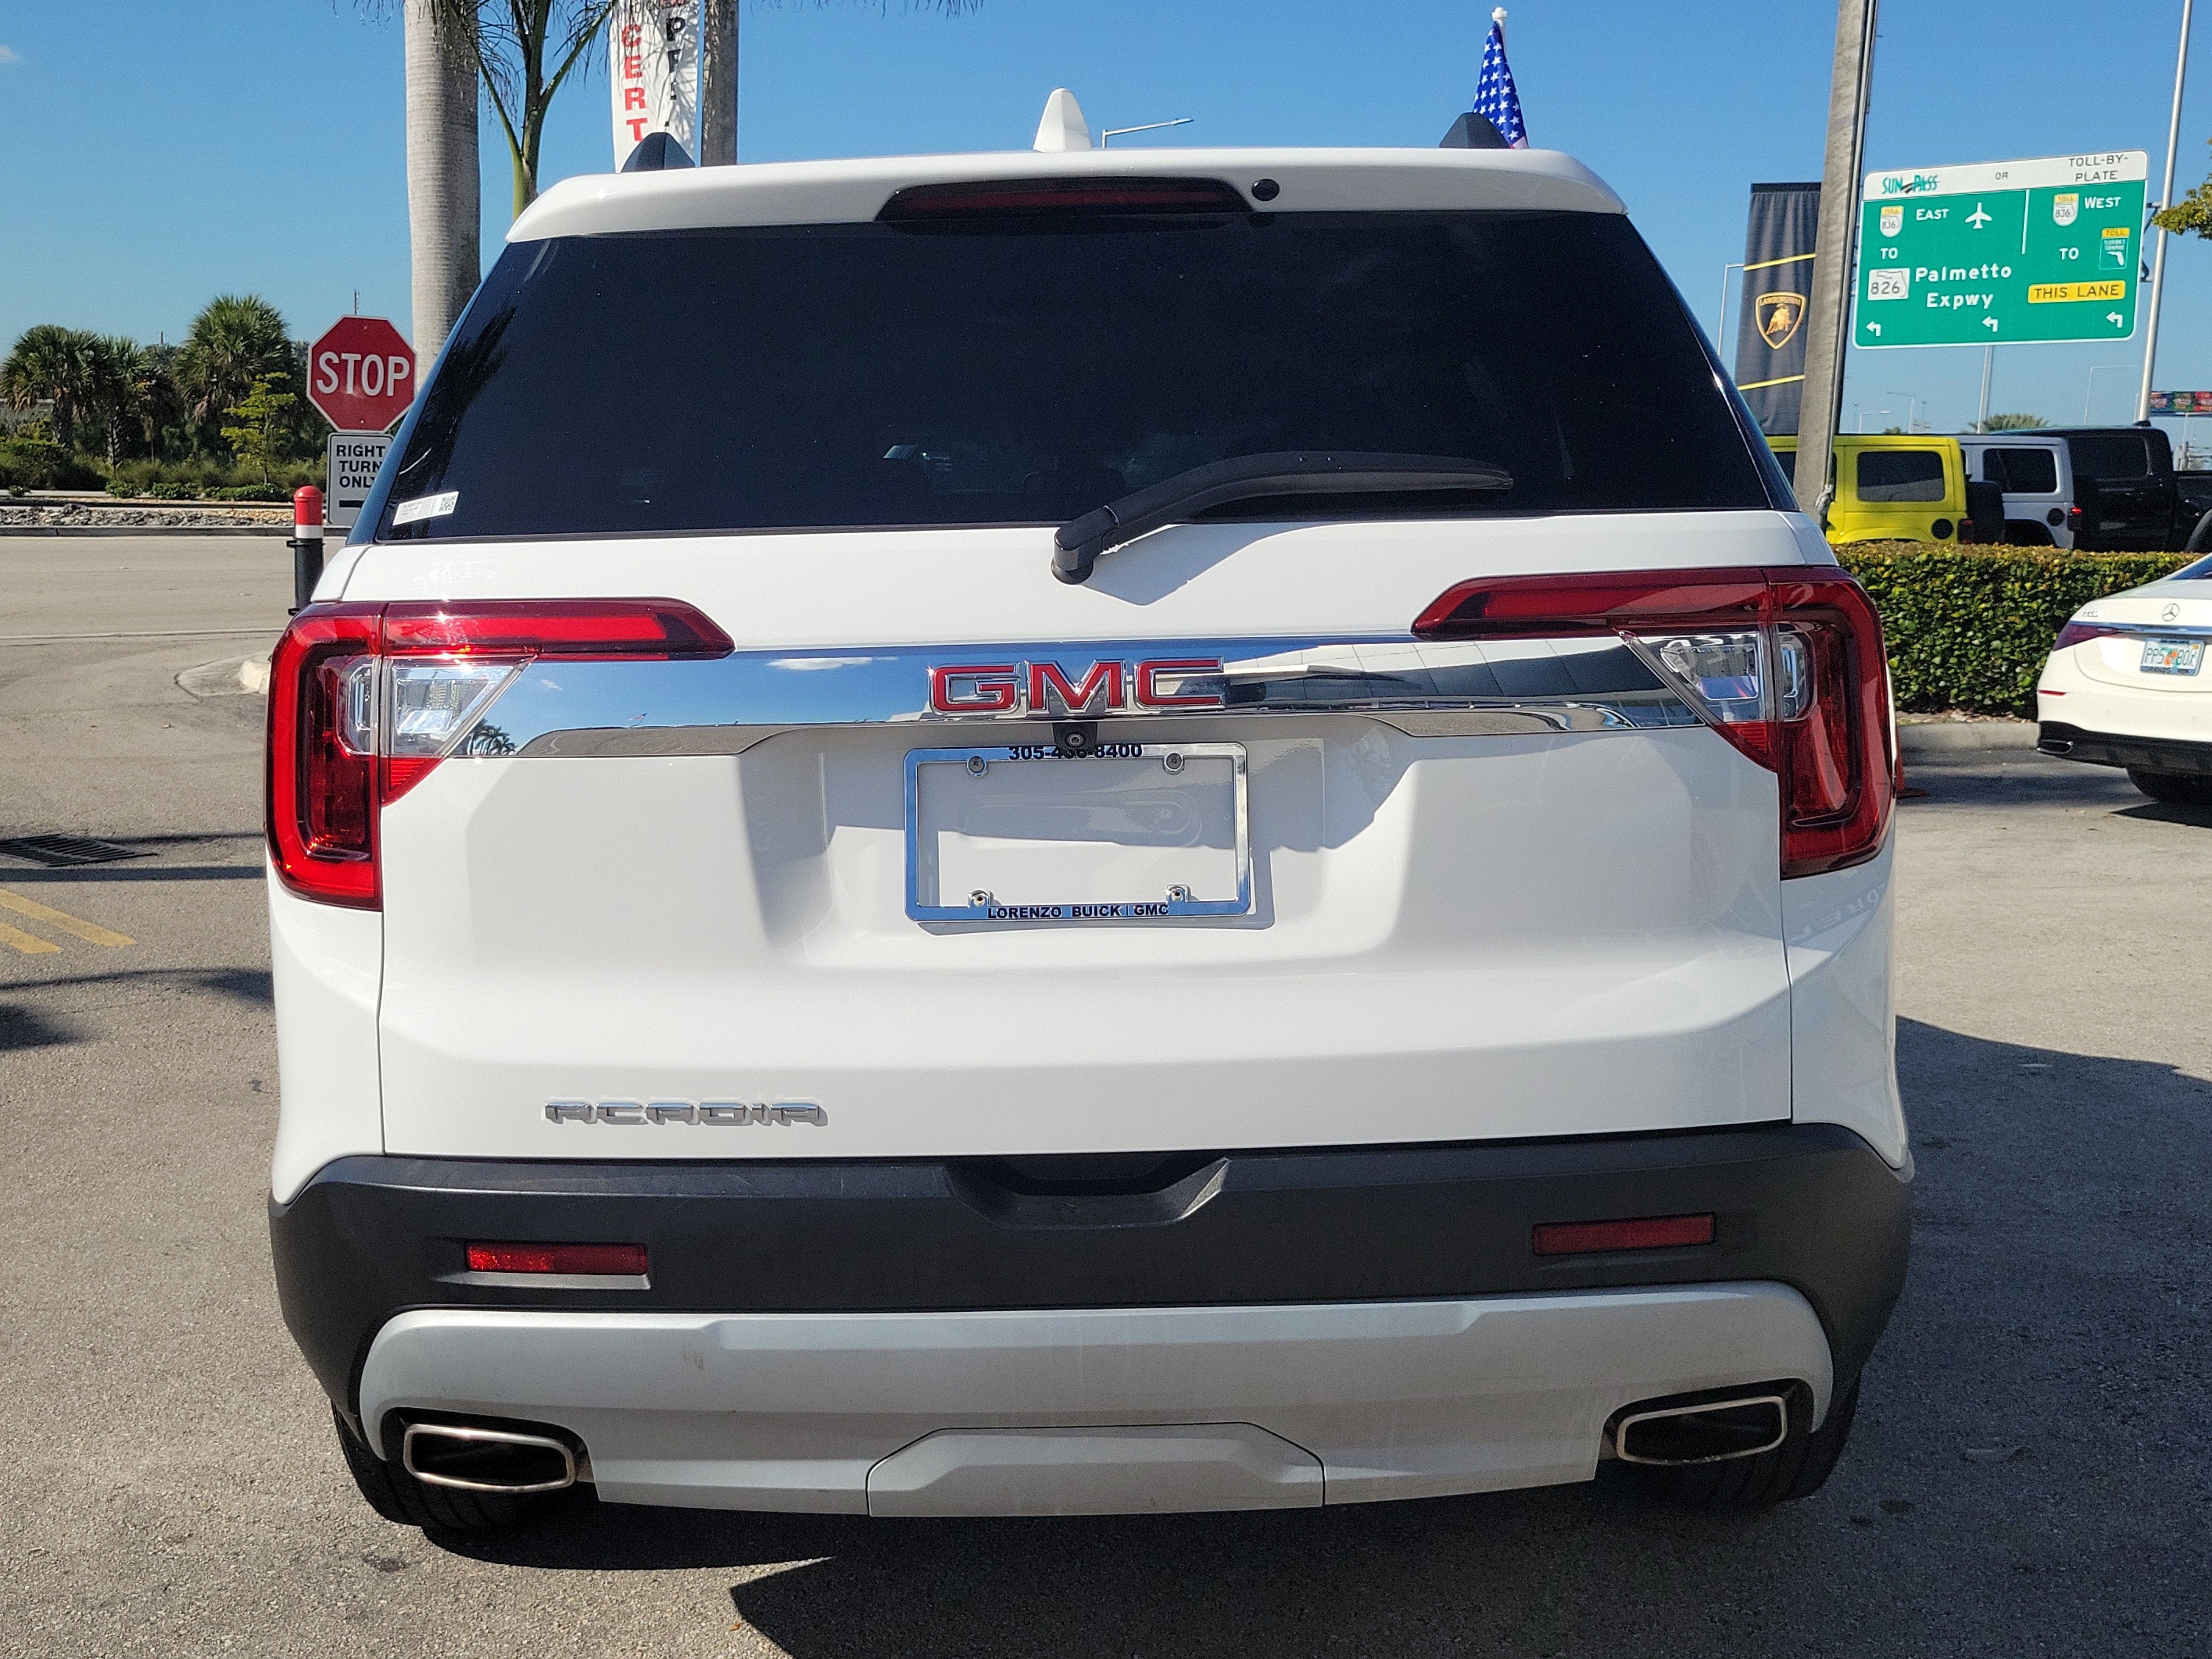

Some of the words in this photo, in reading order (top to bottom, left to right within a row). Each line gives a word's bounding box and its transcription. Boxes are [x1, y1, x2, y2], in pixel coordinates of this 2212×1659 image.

[2068, 154, 2128, 167] TOLL-BY-
[1995, 172, 2008, 180] OR
[2075, 170, 2118, 182] PLATE
[2084, 196, 2121, 208] WEST
[1916, 208, 1949, 221] EAST
[2055, 209, 2070, 218] 836
[1881, 247, 1898, 259] TO
[2059, 247, 2079, 259] TO
[1915, 263, 2012, 282] Palmetto
[1871, 281, 1900, 295] 826
[2034, 287, 2067, 299] THIS
[2078, 284, 2120, 297] LANE
[1927, 292, 1994, 310] Expwy
[316, 351, 410, 396] STOP
[336, 444, 386, 457] RIGHT
[339, 460, 382, 472] TURN
[927, 656, 1225, 714] GMC
[988, 906, 1062, 919] LORENZO
[1071, 905, 1121, 917] BUICK
[1133, 904, 1170, 916] GMC
[545, 1102, 823, 1125] ACADIA
